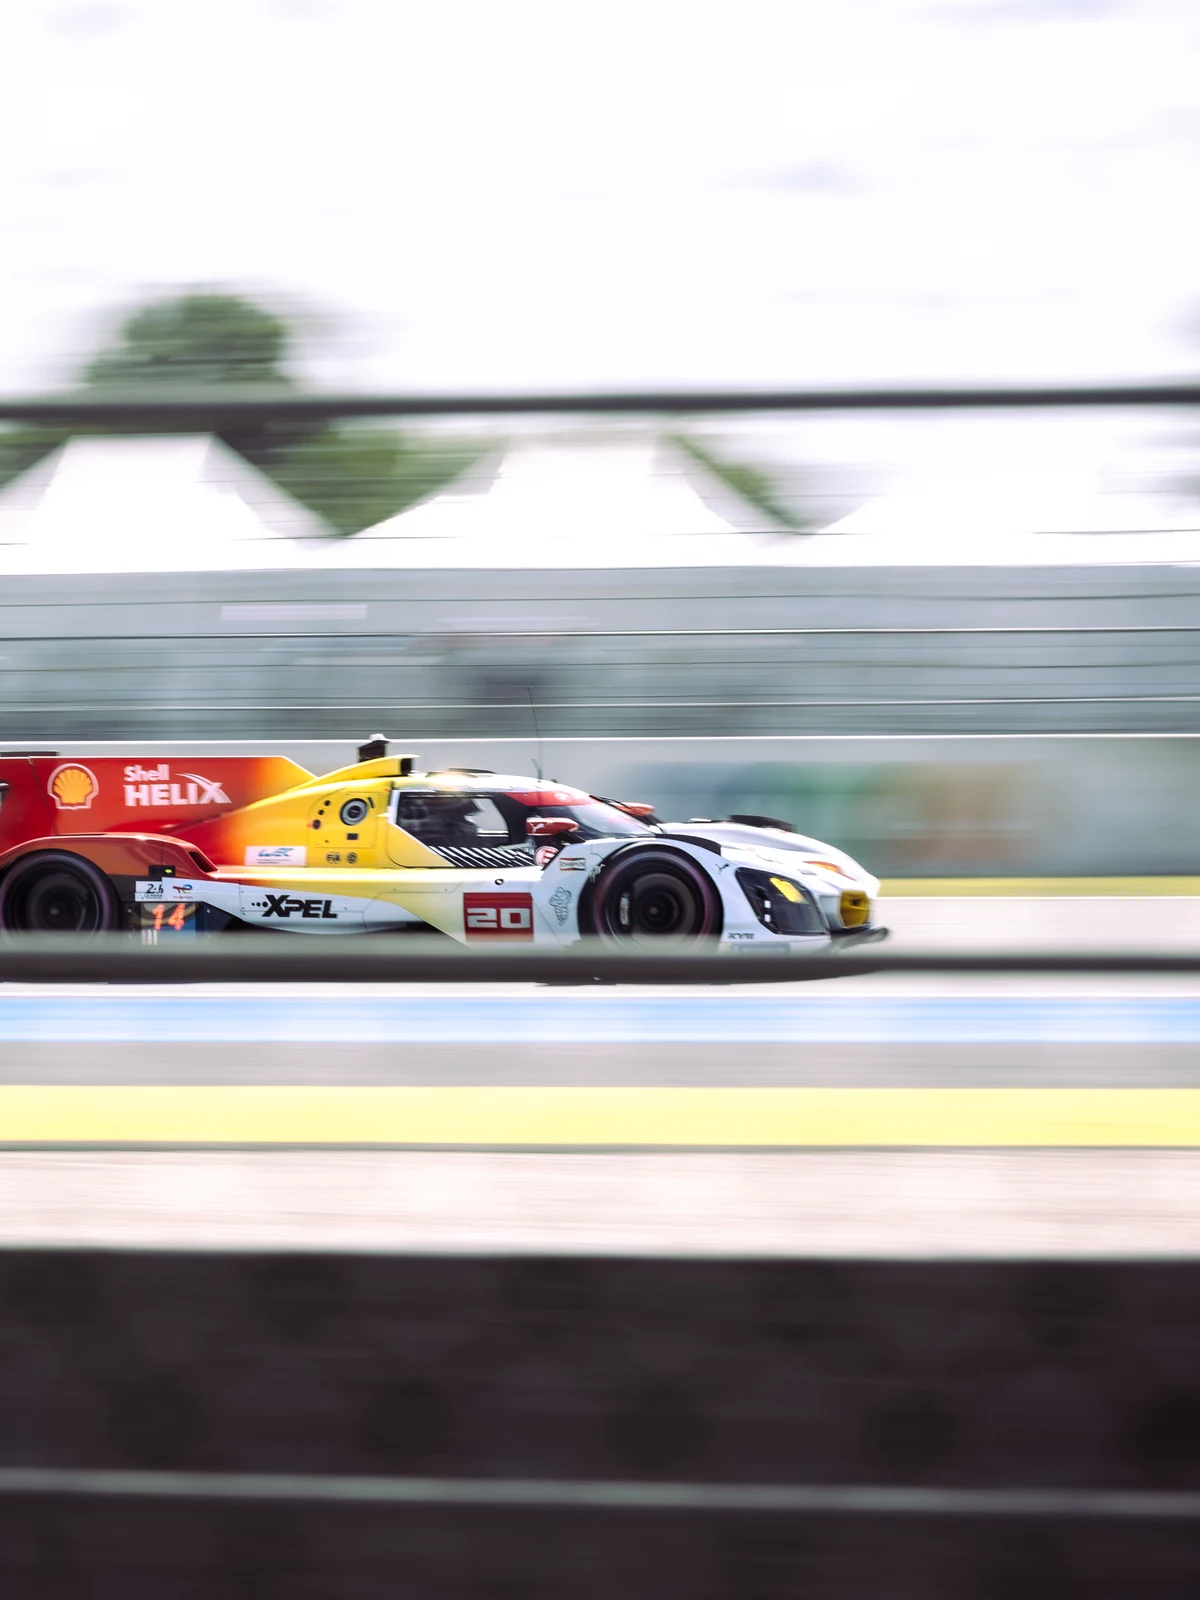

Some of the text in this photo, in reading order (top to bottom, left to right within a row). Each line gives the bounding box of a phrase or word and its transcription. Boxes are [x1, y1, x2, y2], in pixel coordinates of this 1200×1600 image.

[124, 764, 169, 782] Shell
[123, 774, 232, 806] HELIX
[152, 903, 186, 930] 14
[262, 894, 338, 918] XPEL
[467, 907, 531, 929] 20
